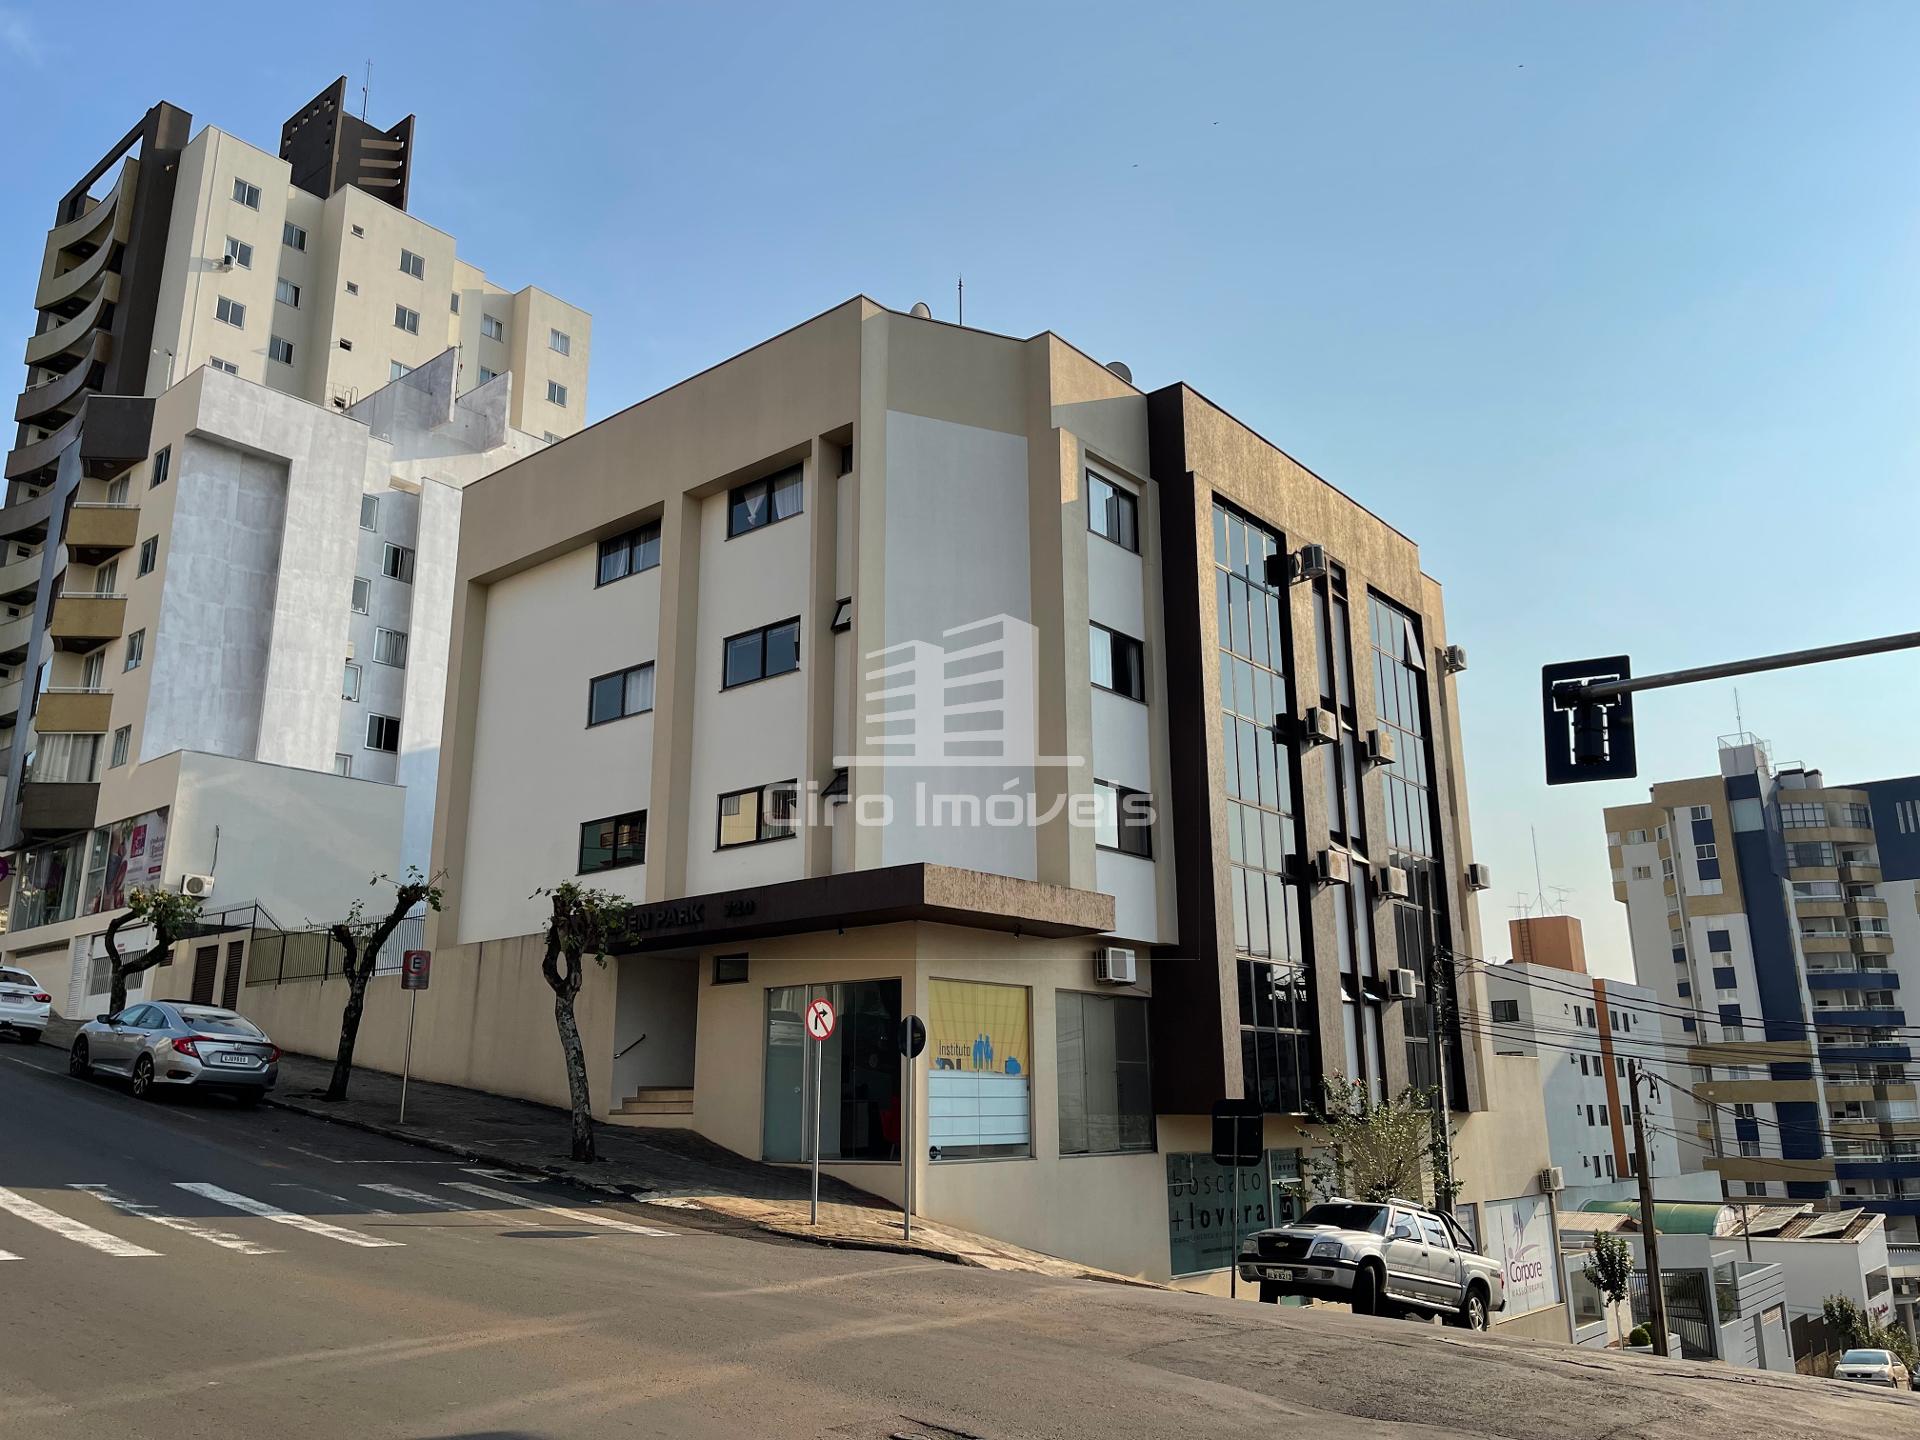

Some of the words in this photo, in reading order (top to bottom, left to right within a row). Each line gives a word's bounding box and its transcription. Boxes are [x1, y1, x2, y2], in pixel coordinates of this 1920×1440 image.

[656, 903, 705, 928] PARK
[412, 957, 425, 970] E
[938, 1040, 971, 1057] Instituto
[1510, 1261, 1543, 1284] Corpore
